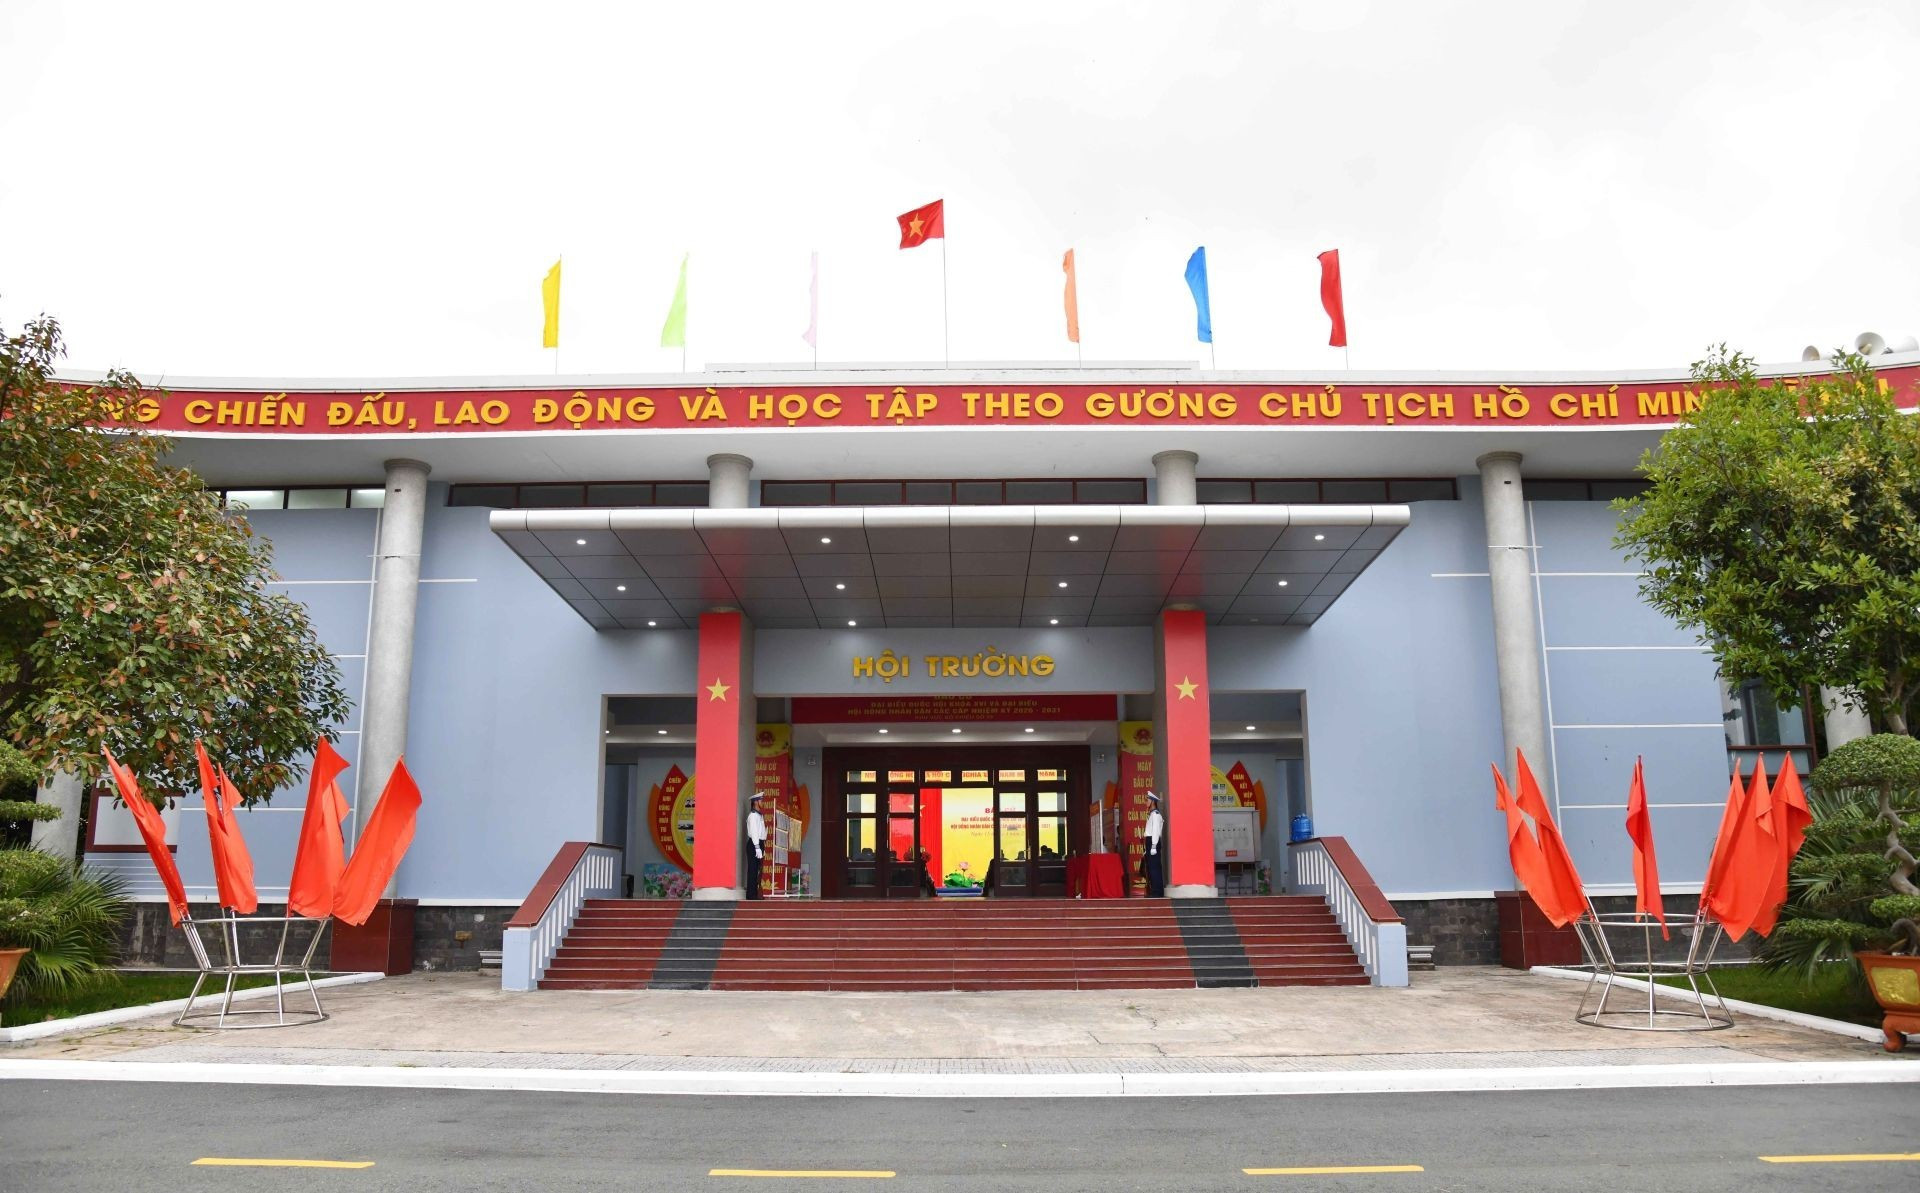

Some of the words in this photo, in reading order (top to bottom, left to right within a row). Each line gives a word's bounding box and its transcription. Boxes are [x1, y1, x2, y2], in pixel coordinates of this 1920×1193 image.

[184, 393, 305, 426] CHIẾN
[327, 392, 417, 429] ĐẤU,
[434, 400, 510, 425] LAO
[534, 391, 655, 430] ĐỘNG
[681, 387, 726, 421] VÀ
[749, 394, 841, 427] HỌC
[867, 387, 938, 424] TẬP
[963, 393, 1064, 418] THEO
[1086, 389, 1237, 418] GƯƠNG
[1259, 385, 1342, 418] CHỦ
[1362, 393, 1454, 424] TỊCH
[1473, 385, 1530, 418] HỒ
[1550, 385, 1619, 418] CHÍ
[1638, 388, 1722, 417] MIN
[853, 649, 910, 683] HỘI
[925, 646, 1056, 679] TRƯỜNG
